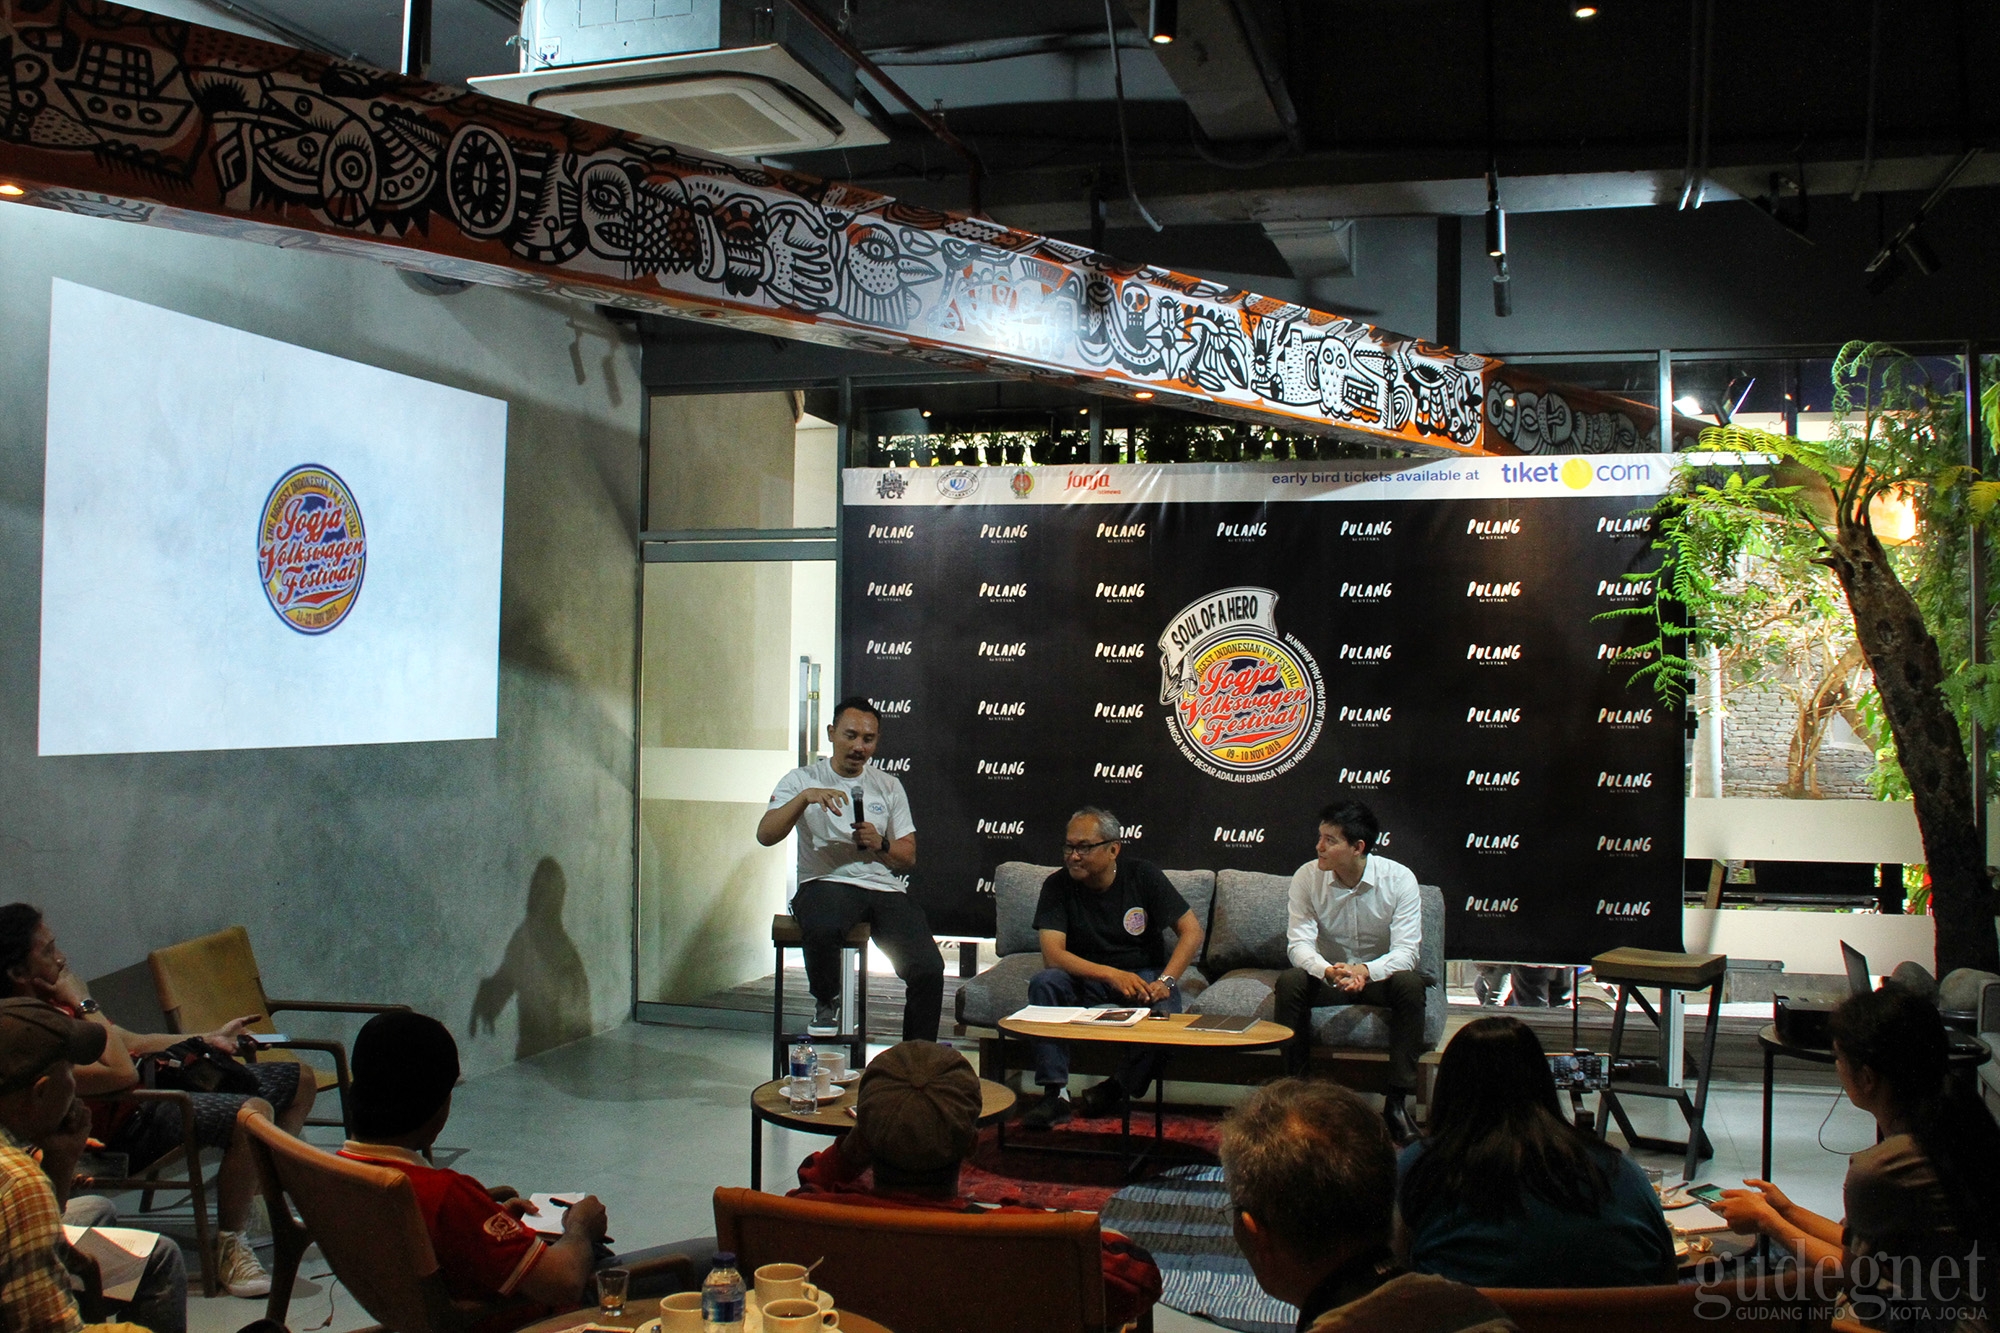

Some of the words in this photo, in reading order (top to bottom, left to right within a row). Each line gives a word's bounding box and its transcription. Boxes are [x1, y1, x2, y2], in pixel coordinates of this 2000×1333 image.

[1272, 472, 1307, 485] early
[1312, 471, 1340, 483] bird
[1344, 470, 1392, 483] tickets
[1396, 469, 1461, 482] available
[1465, 469, 1480, 481] at
[1501, 461, 1559, 483] tiket
[1596, 463, 1650, 482] com
[276, 498, 344, 543] Jogja
[1340, 521, 1392, 536] PULANG
[1467, 519, 1520, 534] PULANG
[868, 524, 914, 538] PULANG
[980, 524, 1028, 538] PULANG
[1096, 523, 1145, 538] PULANG
[1217, 522, 1267, 537] PULANG
[260, 538, 363, 579] Volkswagen
[277, 559, 357, 605] Festival
[867, 582, 913, 596] PULANG
[979, 583, 1027, 597] PULANG
[1095, 582, 1145, 597] PULANG
[1340, 582, 1392, 597] PULANG
[1467, 581, 1521, 597] PULANG
[1597, 581, 1652, 596] PULANG
[1171, 613, 1203, 651] SOUL
[1200, 602, 1217, 631] OF
[1218, 600, 1227, 625] A
[1227, 595, 1258, 623] HERO
[866, 640, 912, 655] PULANG
[978, 641, 1026, 656] PULANG
[1095, 642, 1144, 658] PULANG
[1285, 632, 1322, 679] PAHLAWANNYA
[1340, 644, 1392, 659] PULANG
[1467, 644, 1521, 660] PULANG
[1214, 642, 1261, 659] INDONESIAN
[1262, 646, 1276, 659] VW
[1275, 653, 1300, 687] FESTIVAL
[1199, 660, 1279, 697] Jogja
[1315, 679, 1326, 699] PARA
[978, 701, 1025, 716] PULANG
[1094, 702, 1144, 718] PULANG
[1180, 688, 1307, 726] Volkswagen
[1316, 700, 1327, 719] JASA
[1339, 706, 1391, 722] PULANG
[1467, 707, 1520, 723] PULANG
[1598, 708, 1652, 723] PULANG
[1165, 715, 1184, 747] BANGSA
[1201, 705, 1299, 746] Festival
[1293, 719, 1323, 764] MENGHARGAI
[1179, 743, 1196, 763] YANG
[1226, 748, 1235, 759] 09
[1240, 750, 1249, 760] 10
[1250, 748, 1265, 760] NOV
[1266, 741, 1281, 756] 2019
[977, 760, 1025, 775] PULANG
[1094, 763, 1143, 778] PULANG
[1193, 758, 1217, 777] BESAR
[1276, 758, 1296, 775] YANG
[1216, 770, 1246, 783] ADALAH
[1246, 770, 1278, 784] BANGSA
[1339, 768, 1391, 784] PULANG
[1466, 770, 1520, 786] PULANG
[1597, 772, 1652, 787] PULANG
[977, 819, 1024, 834] PULANG
[1214, 827, 1264, 843] PULANG
[1466, 833, 1519, 849] PULANG
[1597, 836, 1651, 852] PULANG
[1465, 896, 1518, 912] PULANG
[1596, 900, 1650, 916] PULANG
